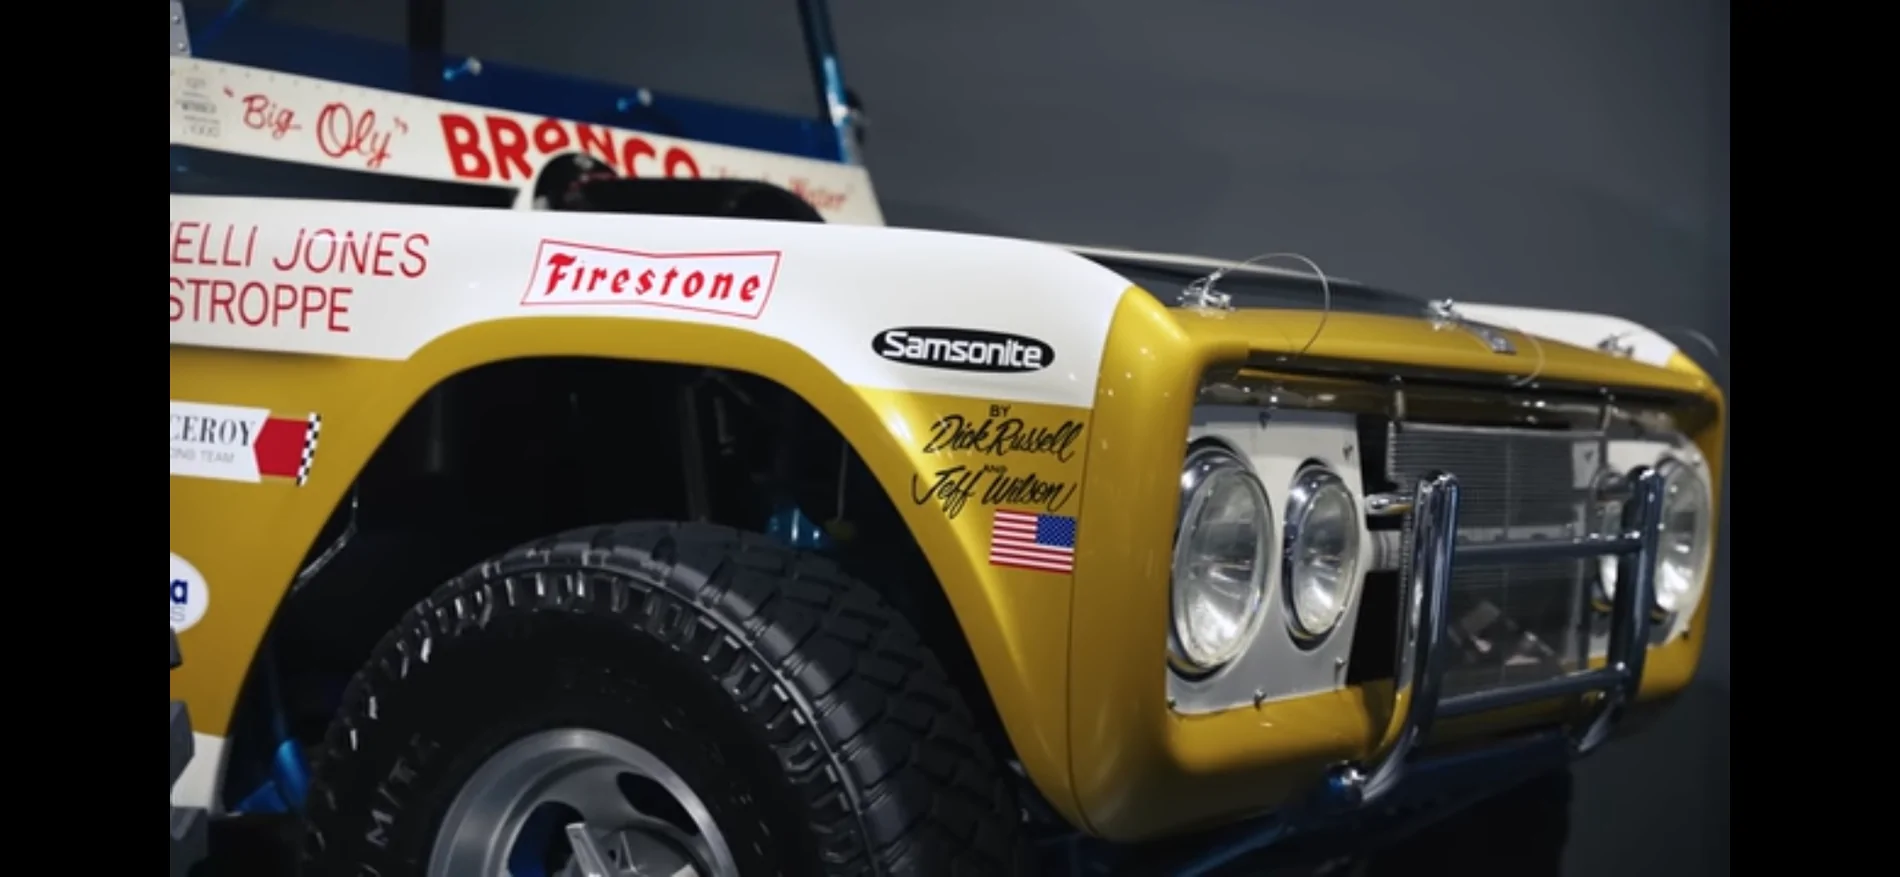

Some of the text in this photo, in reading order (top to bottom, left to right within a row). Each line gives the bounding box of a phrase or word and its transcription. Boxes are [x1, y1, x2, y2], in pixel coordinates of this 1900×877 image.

[170, 221, 430, 279] ELLI JONES
[544, 252, 761, 303] Firestone
[170, 276, 354, 333] STROPPE
[882, 330, 1045, 370] Samsonite
[989, 404, 1011, 418] BY
[923, 414, 1085, 463] Dick Russell
[911, 464, 1078, 520] Jeff Wilson
